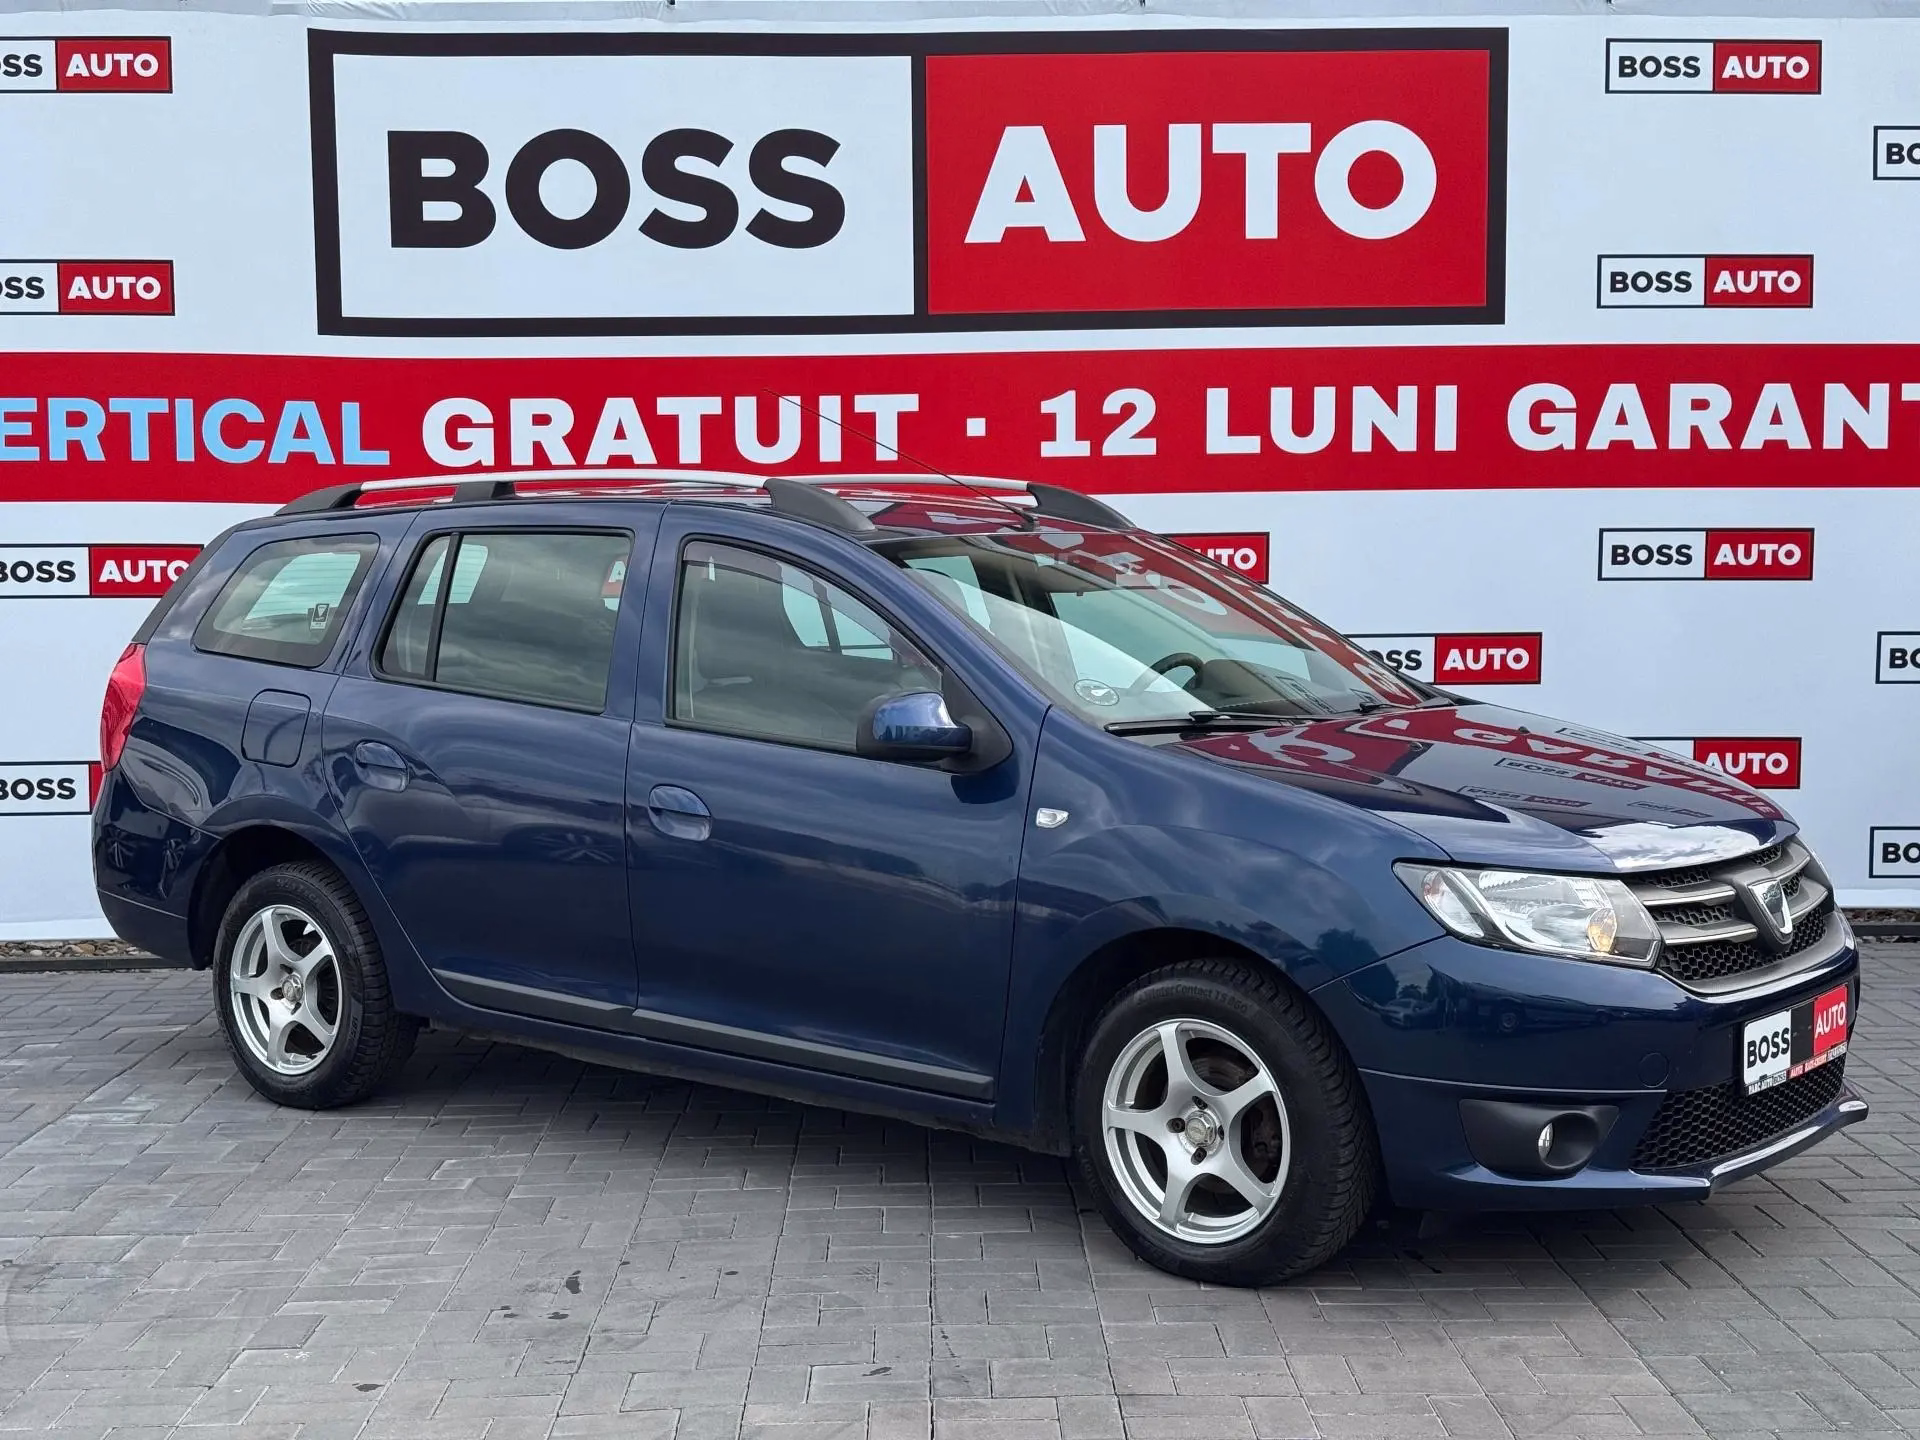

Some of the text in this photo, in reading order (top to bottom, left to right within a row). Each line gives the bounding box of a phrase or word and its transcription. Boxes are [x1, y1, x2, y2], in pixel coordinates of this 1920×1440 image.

[0, 54, 158, 77] SS AUTO
[1619, 56, 1809, 78] BOSS AUTO
[388, 120, 1436, 249] BOSS AUTO
[0, 277, 161, 299] SS AUTO
[1610, 271, 1800, 293] BOSS AUTO
[423, 394, 918, 469] GRATUIT
[1041, 389, 1156, 457] 12
[1207, 386, 1457, 454] LUNI
[1508, 383, 1920, 451] GARAN
[1612, 544, 1801, 565] BOSS AUTO
[1443, 648, 1529, 670] AUTO
[1706, 752, 1789, 775] AUTO
[1882, 843, 1920, 863] BO
[1747, 1027, 1790, 1068] BOSS
[1815, 1001, 1846, 1038] AUTO
